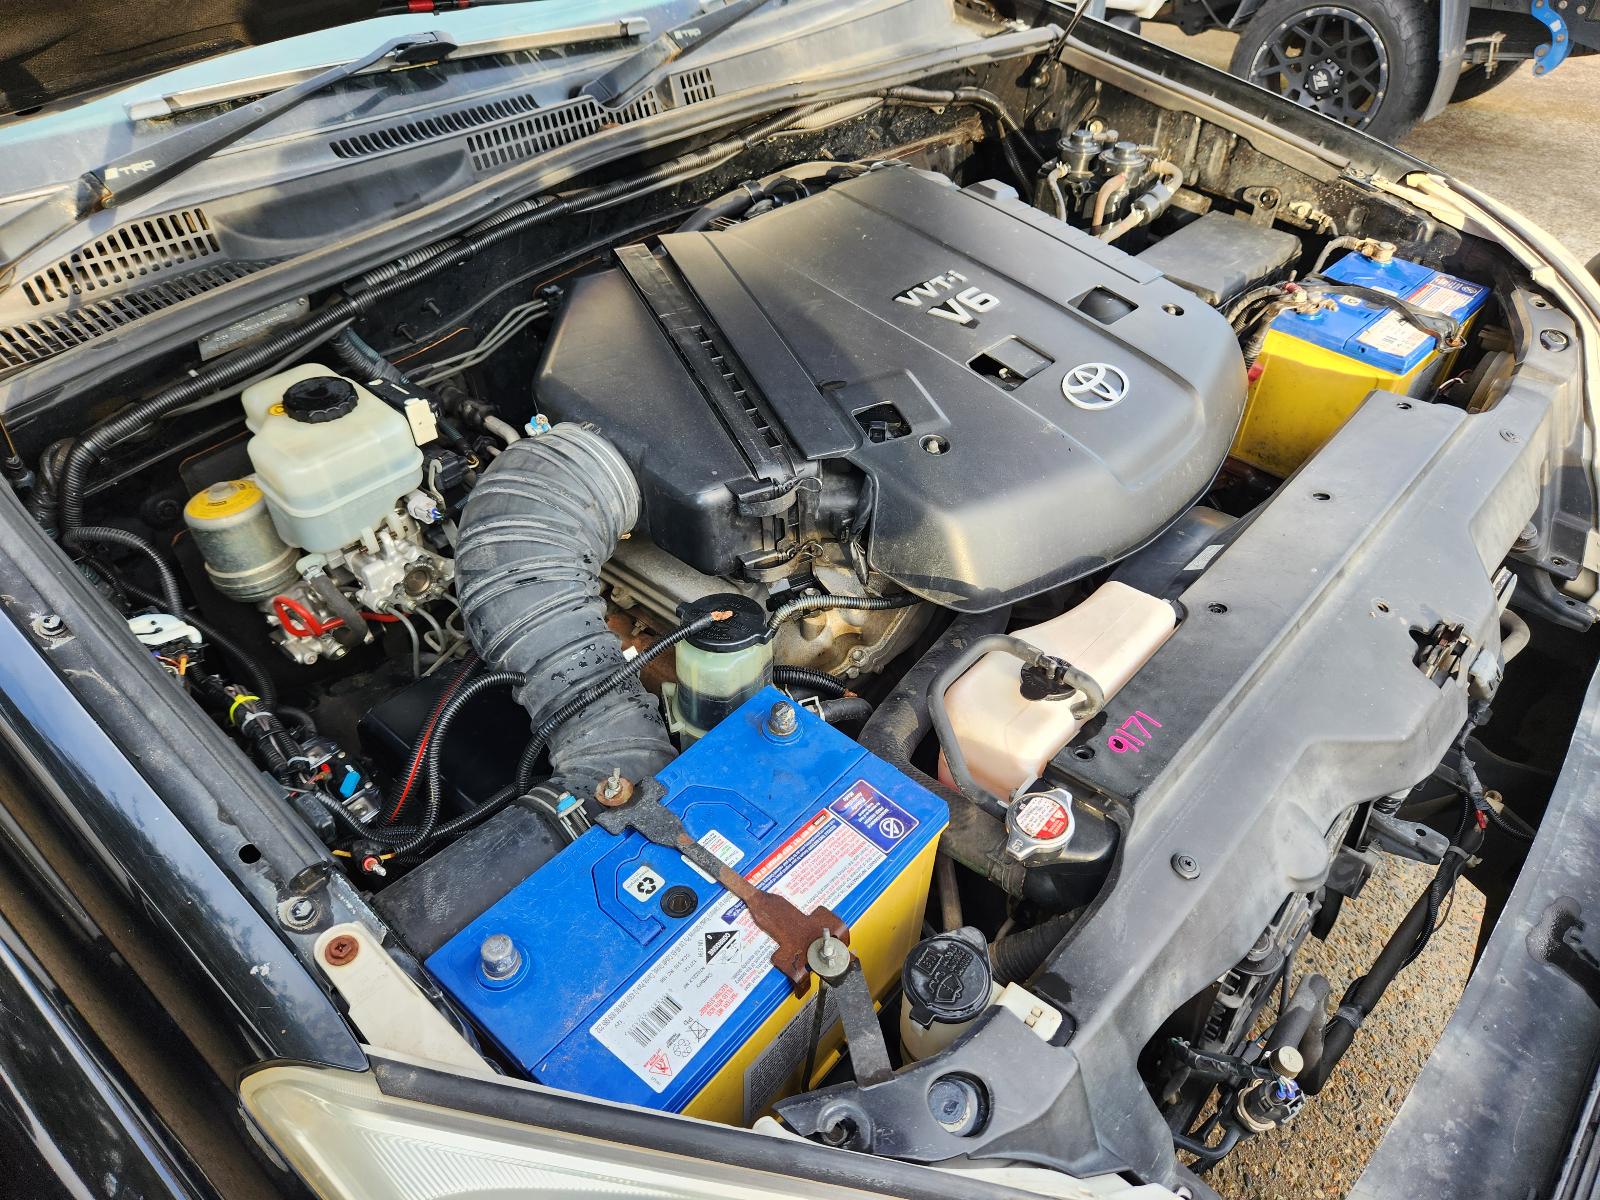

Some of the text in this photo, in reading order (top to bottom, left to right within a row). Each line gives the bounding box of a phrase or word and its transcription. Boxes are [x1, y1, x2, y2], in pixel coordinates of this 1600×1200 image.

[118, 160, 156, 175] TRD
[926, 286, 1000, 325] V6
[1108, 710, 1162, 753] 9171
[841, 790, 854, 802] Made
[707, 931, 731, 956] CORROSIVE
[695, 972, 712, 988] Century
[682, 1015, 693, 1026] Pb
